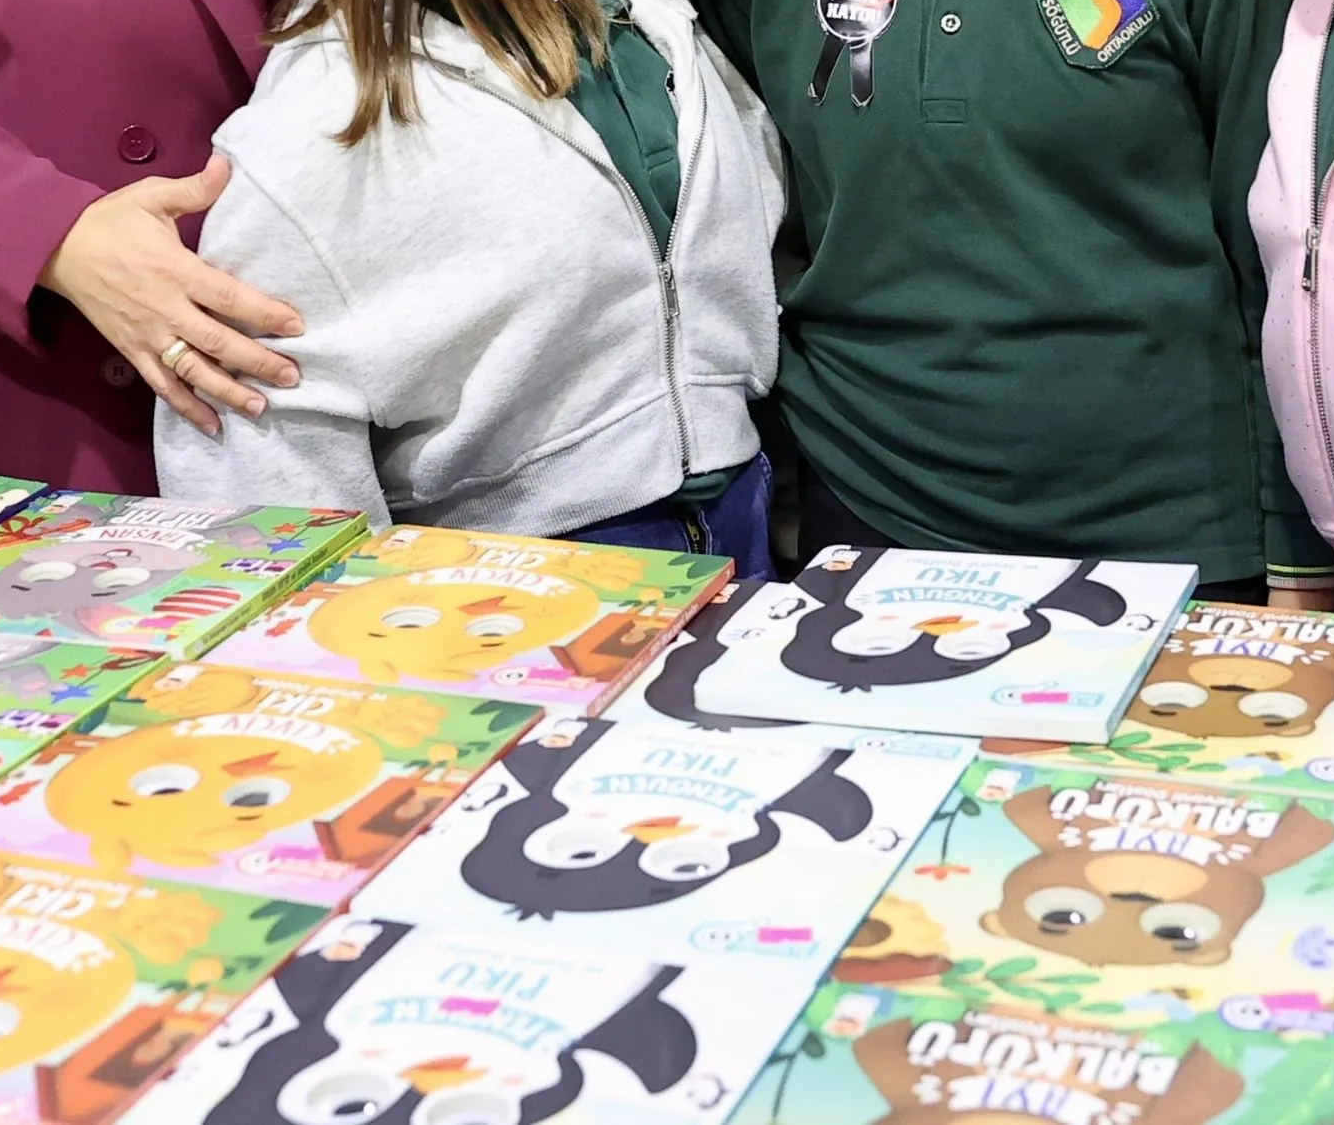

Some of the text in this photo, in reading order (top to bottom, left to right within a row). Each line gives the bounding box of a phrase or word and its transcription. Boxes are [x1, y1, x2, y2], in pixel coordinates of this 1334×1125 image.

[1097, 10, 1153, 62] ORTAOKULU
[108, 507, 215, 530] TAPTAP
[891, 588, 1007, 612] PENGUEN
[1048, 788, 1280, 838] BALKÜPÜ
[906, 1019, 1179, 1094] BALKÜPÜ
